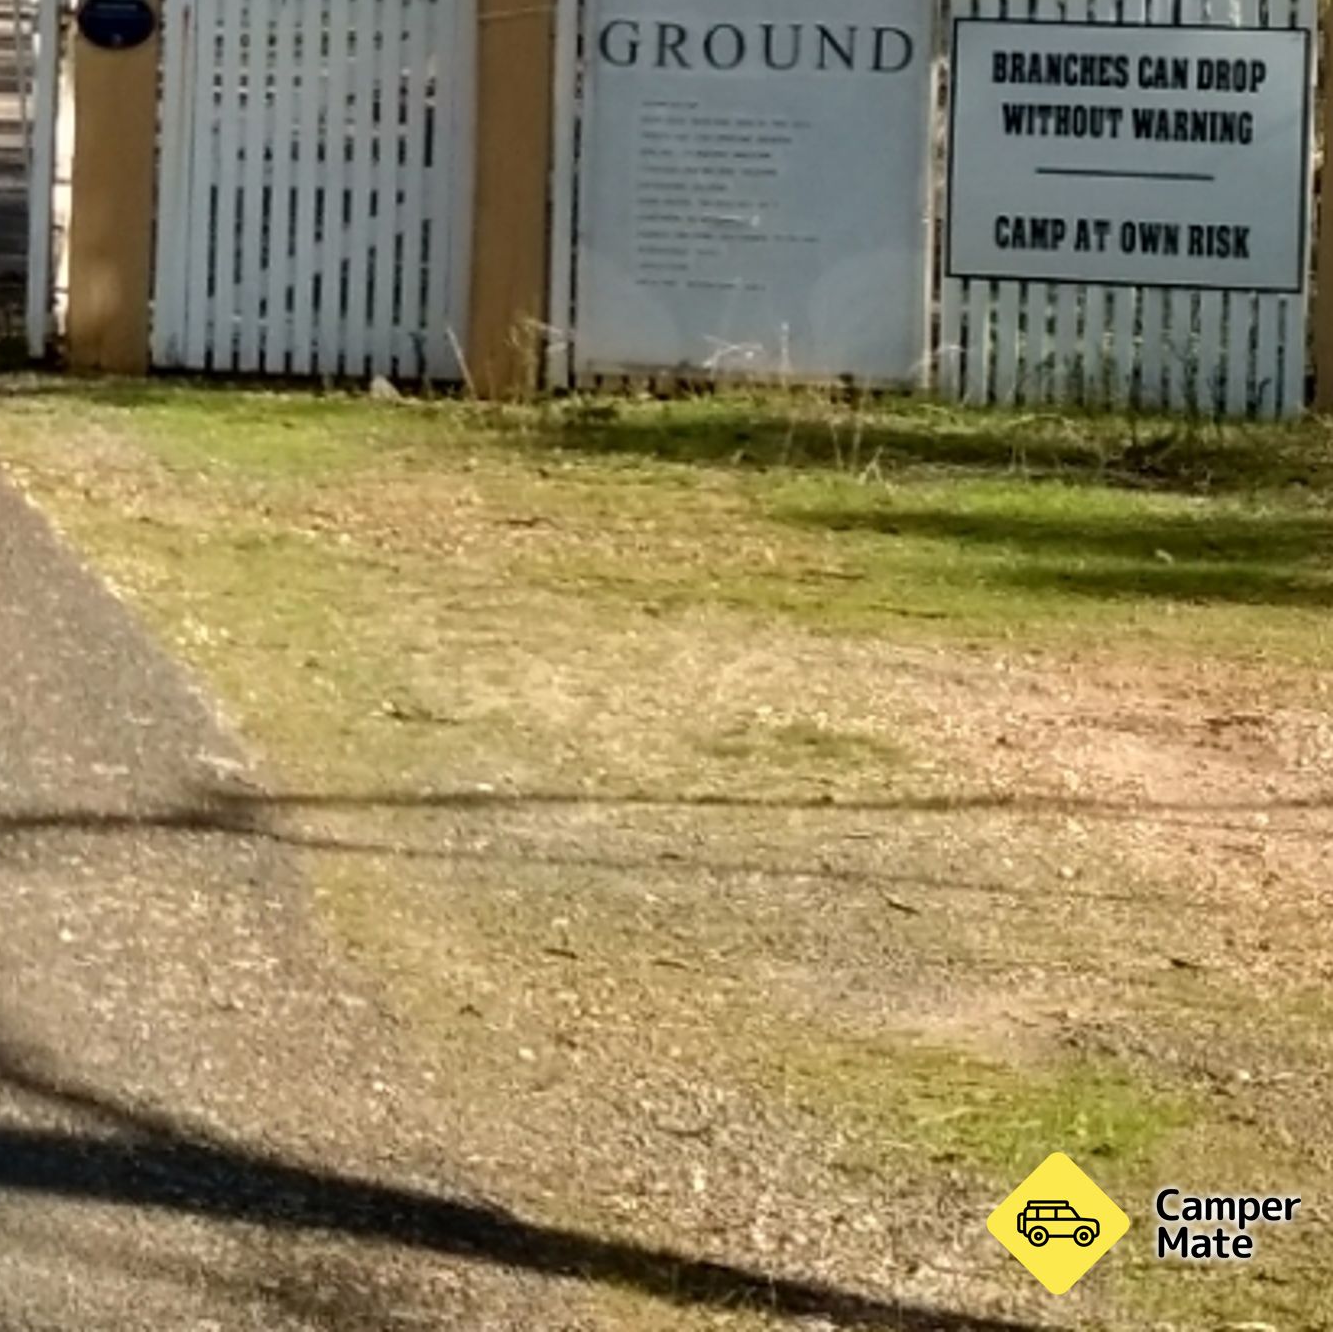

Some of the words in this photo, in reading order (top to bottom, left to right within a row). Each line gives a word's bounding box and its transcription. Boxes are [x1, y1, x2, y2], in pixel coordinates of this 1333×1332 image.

[598, 20, 915, 73] GROUND
[992, 51, 1129, 88] BRANCHES
[1137, 56, 1188, 90] CAN
[1196, 58, 1267, 93] DROP
[1002, 104, 1123, 139] WITHOUT
[1132, 108, 1253, 144] WARNING
[995, 216, 1065, 251] CAMP
[1074, 220, 1110, 252] AT
[1120, 222, 1180, 255] OWN
[1187, 225, 1250, 259] RISK
